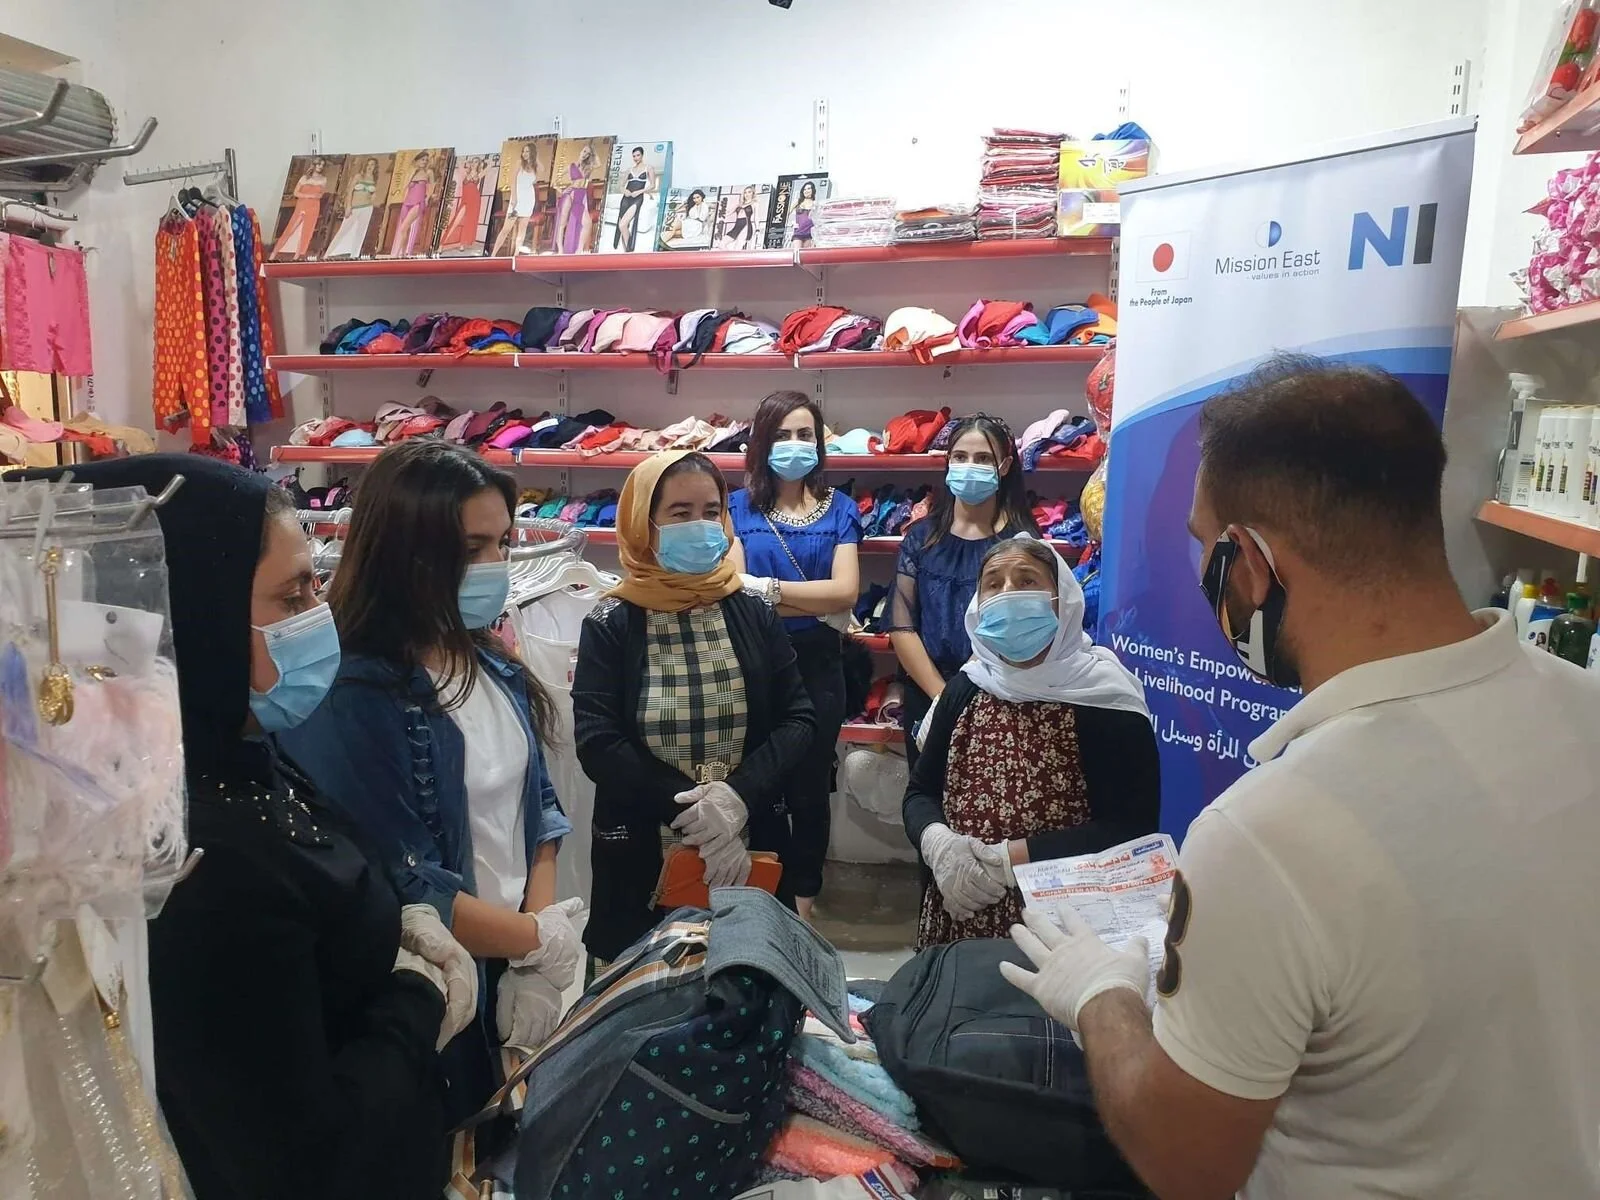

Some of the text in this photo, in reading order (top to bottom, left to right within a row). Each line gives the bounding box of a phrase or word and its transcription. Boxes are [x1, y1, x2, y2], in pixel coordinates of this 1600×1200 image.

[663, 190, 679, 231] PASSIONE
[771, 182, 788, 224] PASSIONE
[1348, 203, 1438, 270] NI
[1215, 249, 1321, 275] Mission East
[1251, 268, 1320, 281] values in action
[1129, 295, 1193, 308] the People of Japan
[1150, 288, 1168, 296] From
[1111, 632, 1185, 666] Women's
[1161, 719, 1203, 752] وسبل
[1207, 729, 1240, 760] المرأة
